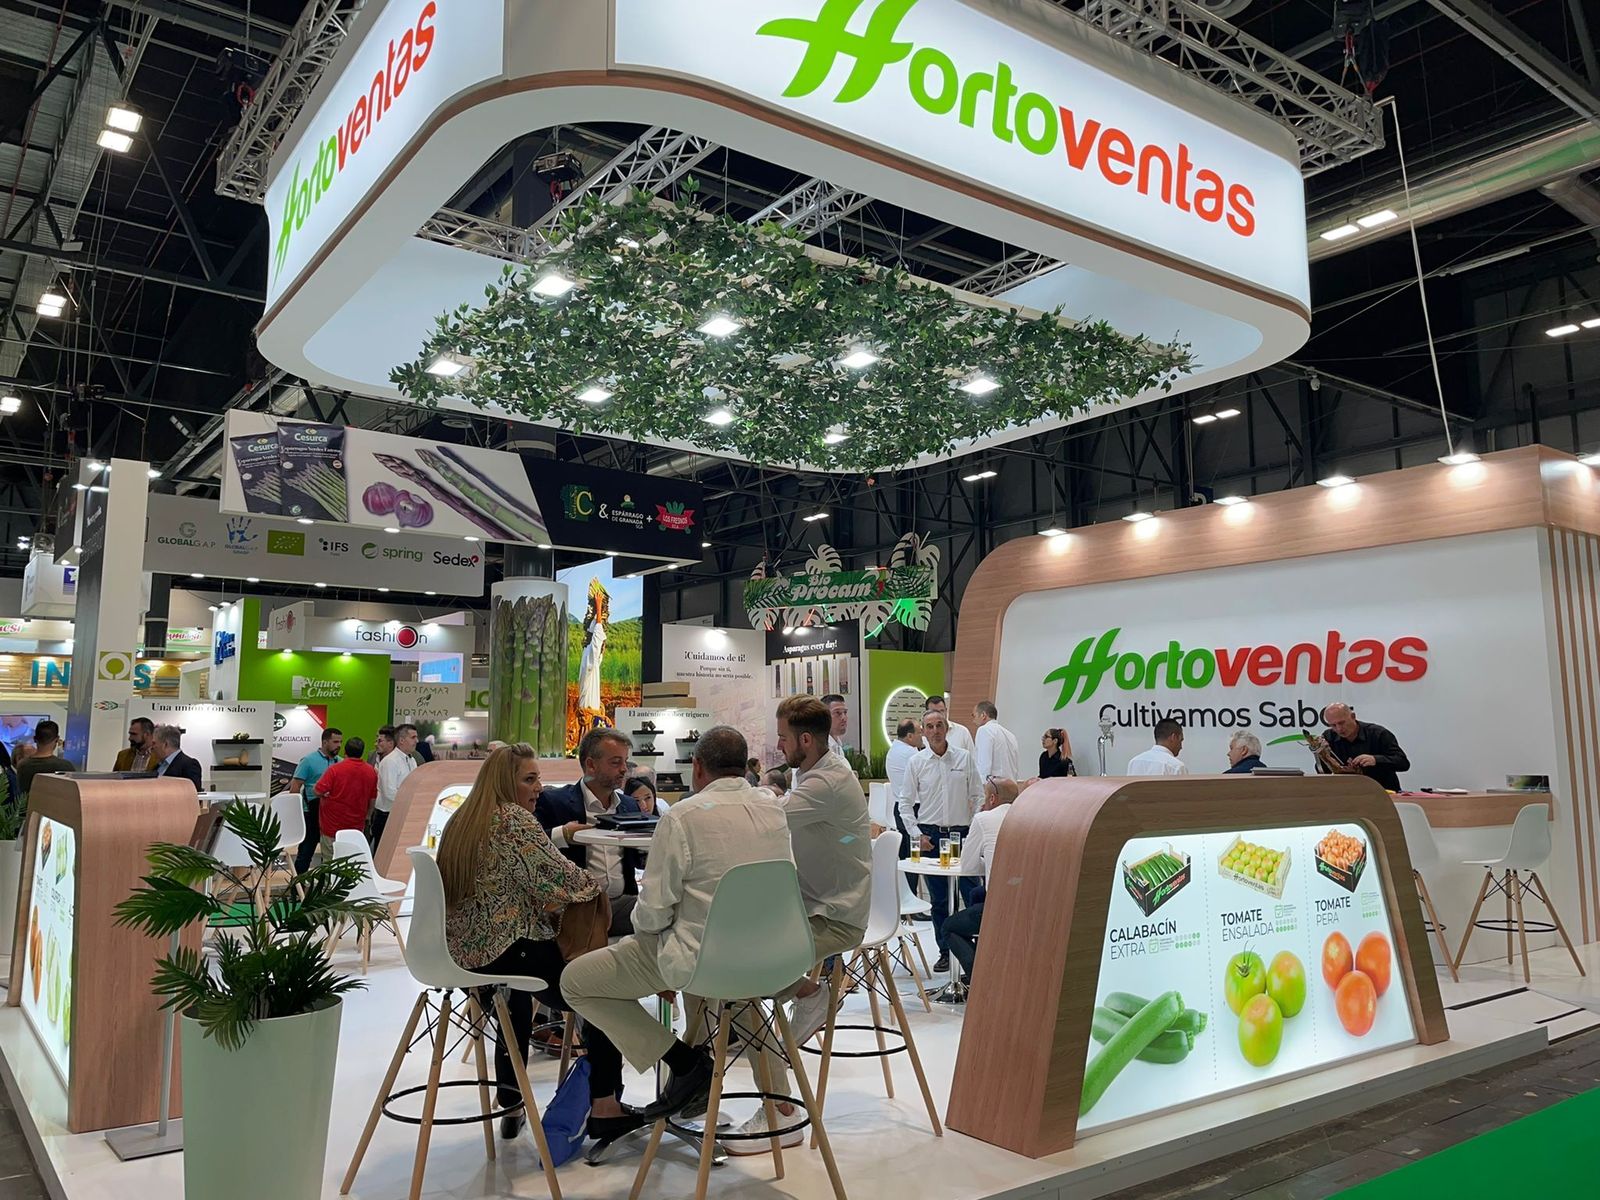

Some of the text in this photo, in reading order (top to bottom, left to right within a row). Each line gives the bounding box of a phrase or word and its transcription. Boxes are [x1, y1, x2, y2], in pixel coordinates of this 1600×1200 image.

[755, 0, 1256, 237] Hortoventas
[271, 1, 437, 289] Hortoventas
[294, 432, 328, 443] Cesurca
[598, 503, 609, 519] &
[330, 541, 349, 552] IFS
[382, 547, 423, 563] spring
[433, 551, 478, 567] Sedex
[808, 574, 832, 587] Bio
[791, 581, 871, 602] Procam
[684, 651, 725, 661] ¡Cuidamos
[726, 653, 736, 662] de
[1043, 627, 1429, 711] Hortoventas
[304, 677, 341, 689] Nature
[306, 687, 344, 698] Choice
[151, 702, 172, 712] Una
[227, 704, 256, 713] salero
[685, 711, 710, 719] triguero
[1099, 701, 1251, 728] Cultivamos
[1315, 896, 1351, 912] TOMATE
[1220, 908, 1263, 926] TOMATE
[1315, 911, 1340, 927] PERA
[1109, 917, 1177, 943] CALABACÍN
[1222, 921, 1275, 942] ENSALADA
[1110, 941, 1146, 960] EXTRA
